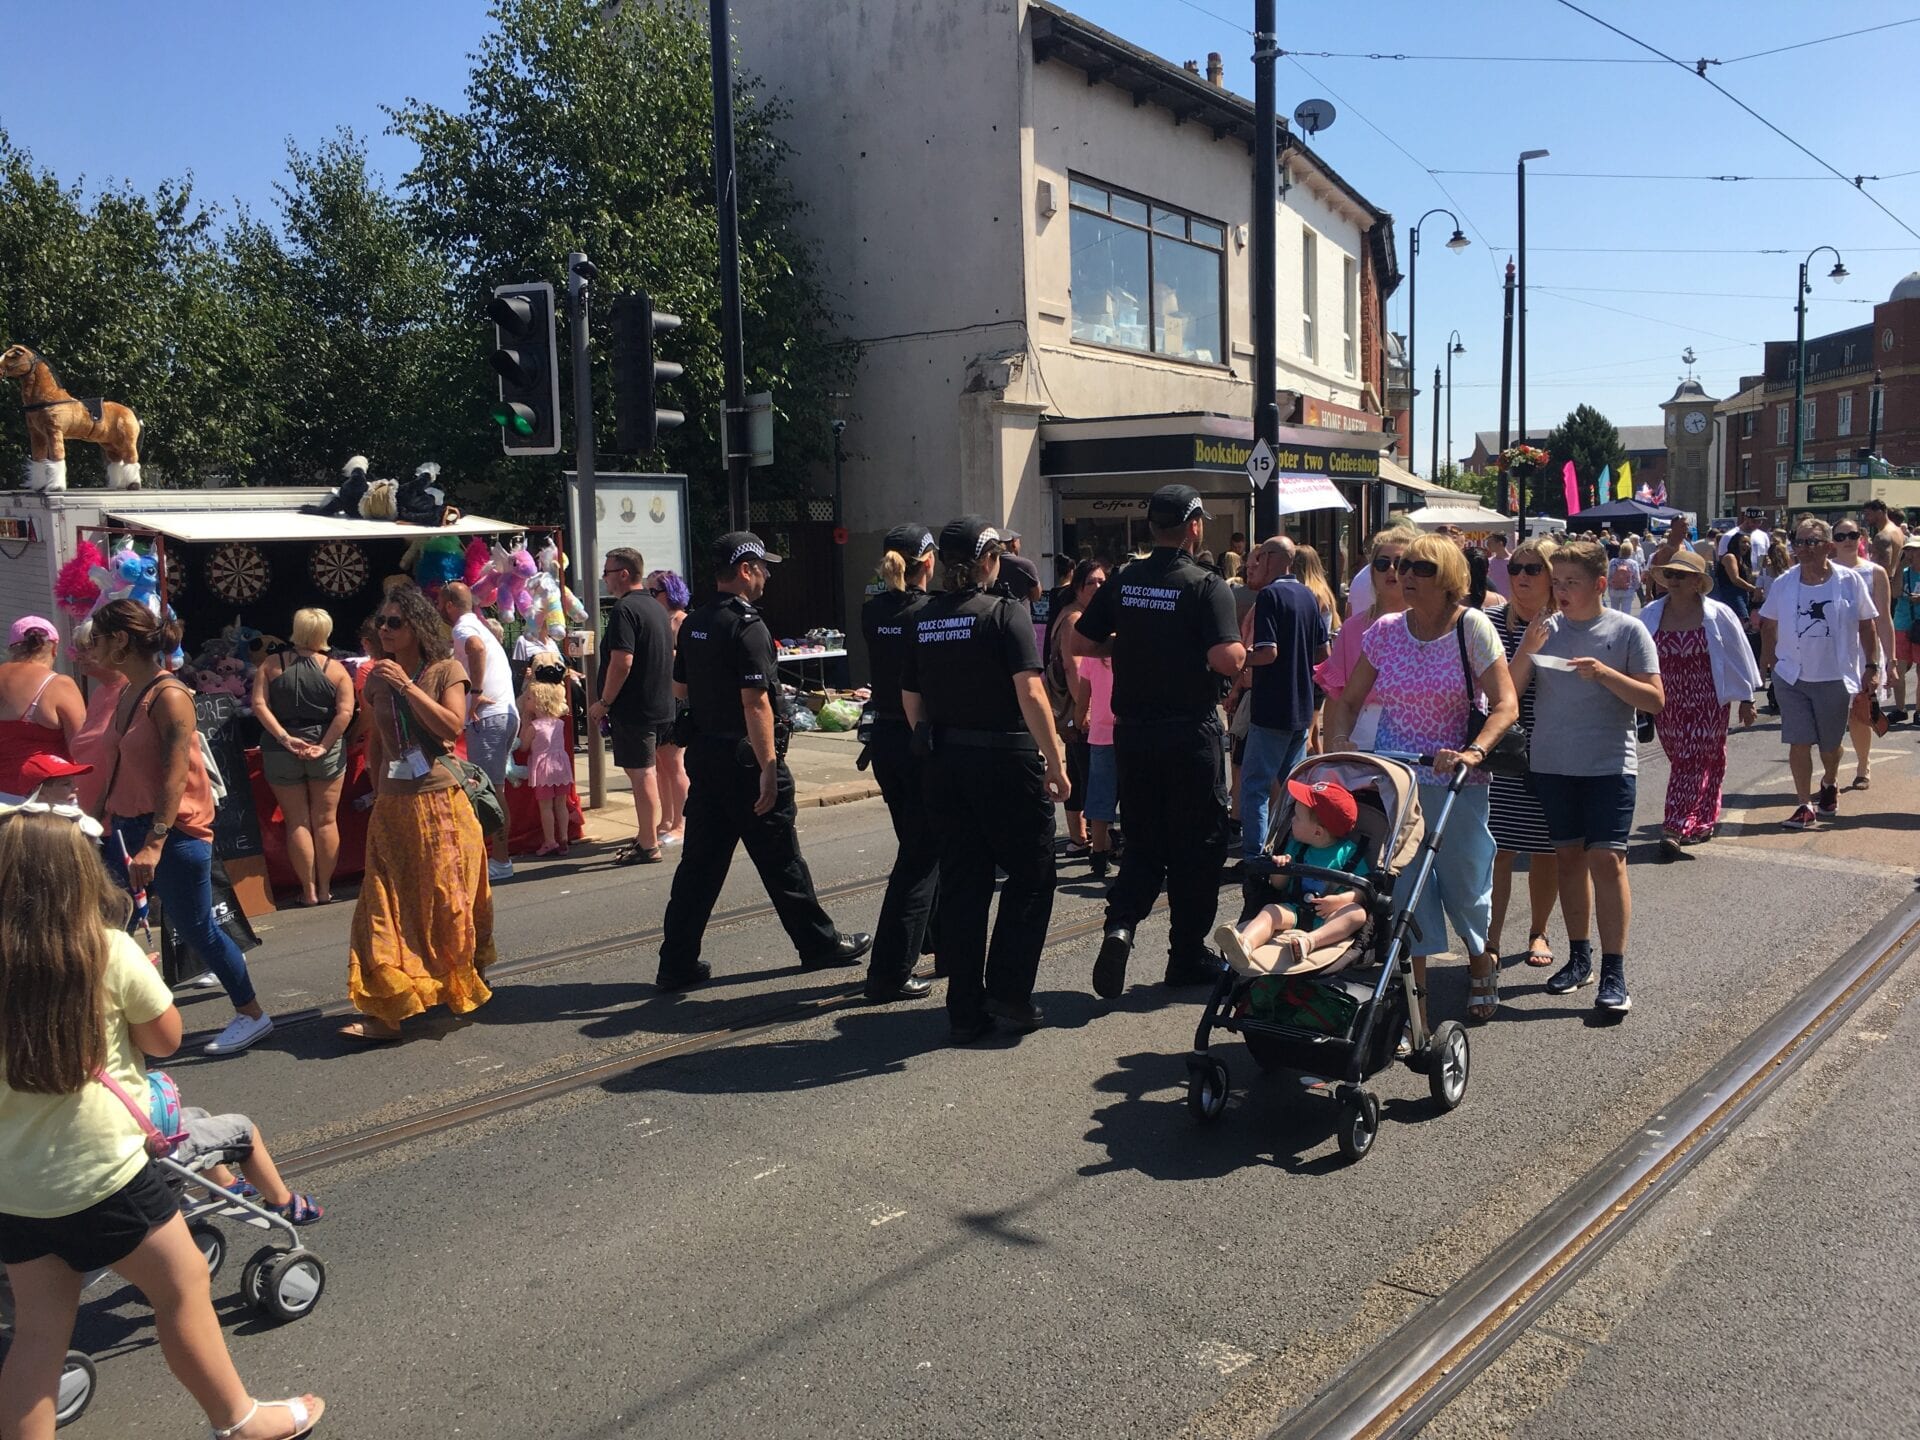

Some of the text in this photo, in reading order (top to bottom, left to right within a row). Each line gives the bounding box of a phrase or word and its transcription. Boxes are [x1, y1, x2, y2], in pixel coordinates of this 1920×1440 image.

[1321, 411, 1342, 430] HOME
[1253, 456, 1269, 471] 15
[1279, 450, 1299, 470] pter
[1304, 452, 1324, 470] two
[1329, 452, 1378, 476] Coffeeshop
[1092, 501, 1133, 511] Coffee
[1121, 584, 1181, 599] POLICE COMMUNITY
[1122, 596, 1175, 611] SUPPORT OFFICER
[877, 626, 902, 635] POLICE
[917, 616, 976, 631] POLICE COMMUNITY
[691, 631, 708, 640] POLICE
[918, 628, 971, 643] SUPPORT OFFICER
[196, 697, 229, 720] ORE
[211, 901, 228, 918] rs
